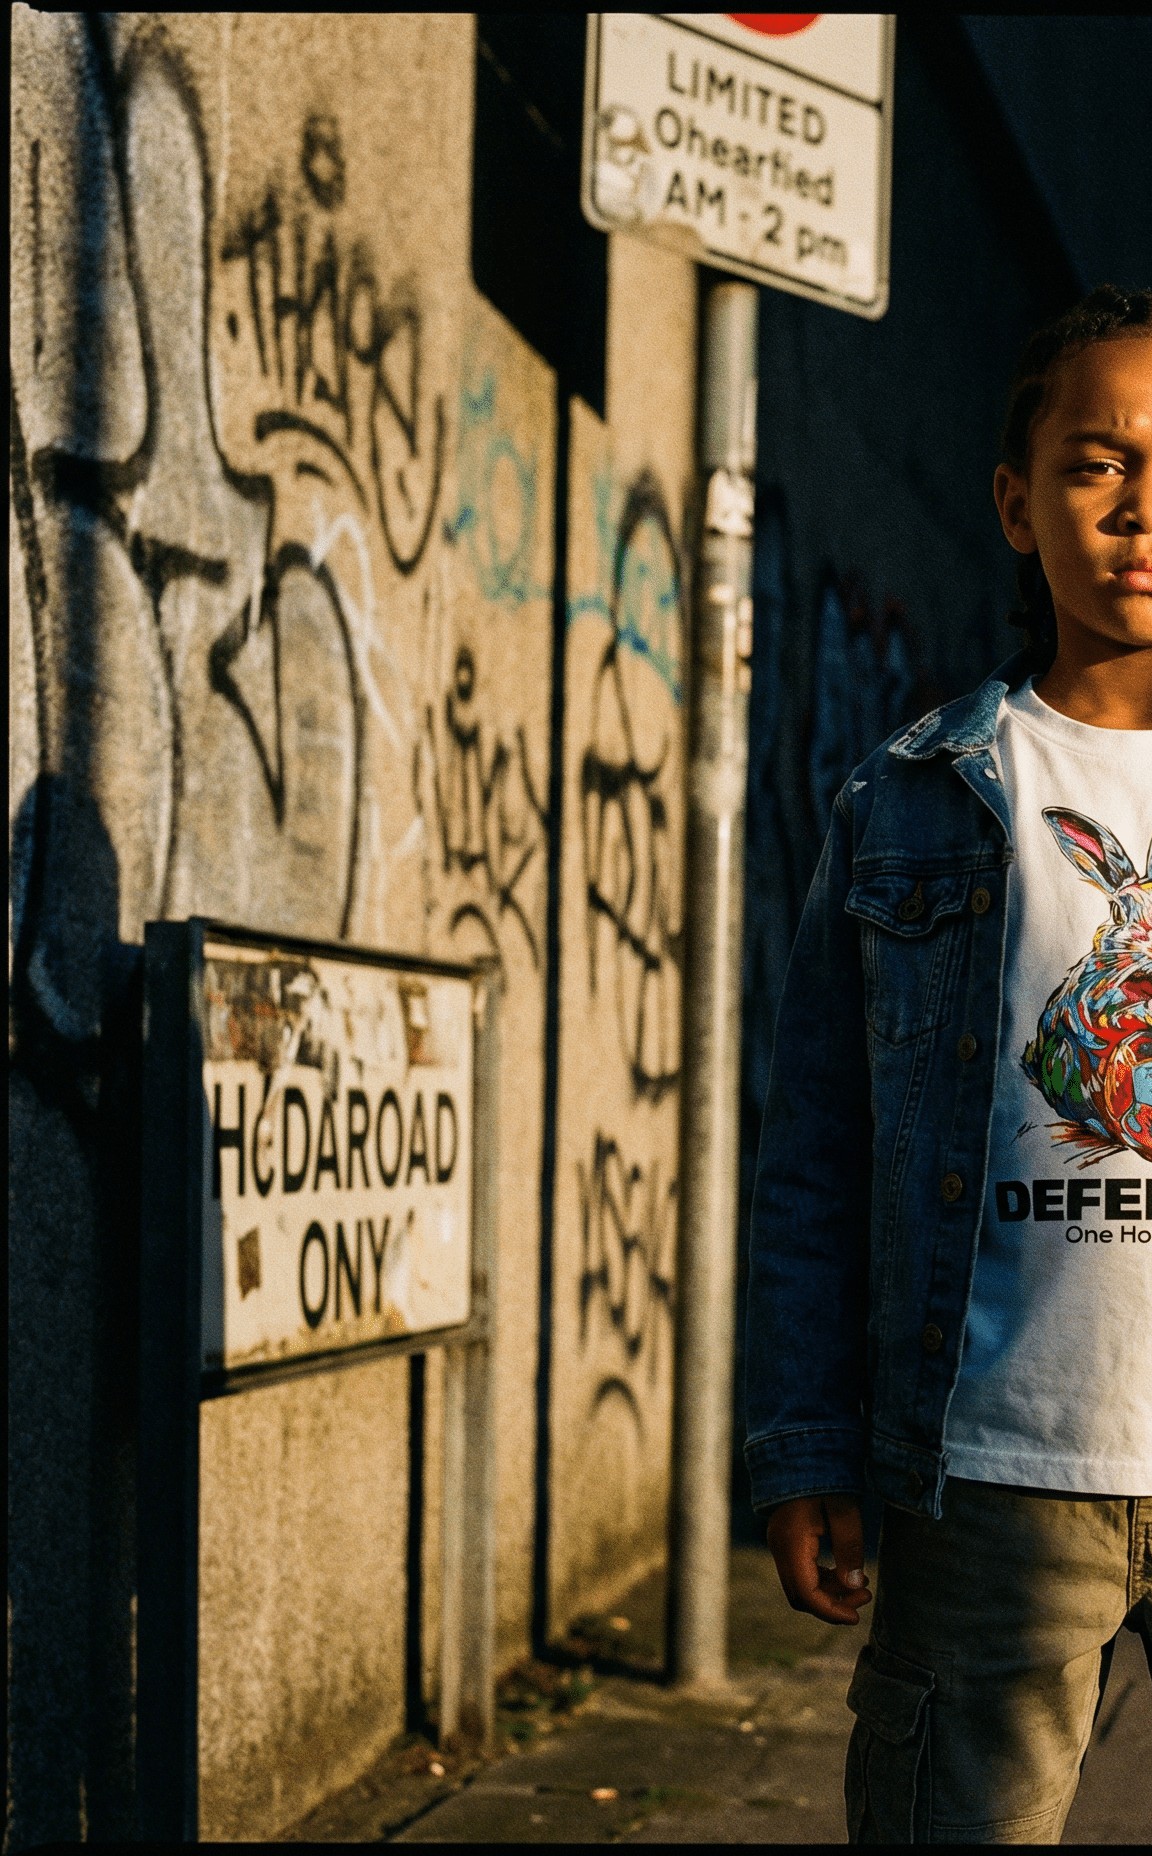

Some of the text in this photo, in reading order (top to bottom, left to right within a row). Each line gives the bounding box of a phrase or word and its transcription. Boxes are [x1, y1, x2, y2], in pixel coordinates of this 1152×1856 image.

[667, 51, 826, 146] LIMITED
[664, 171, 725, 227] AM
[763, 203, 784, 246] 2
[796, 226, 848, 268] pm
[1065, 1225, 1113, 1244] One
